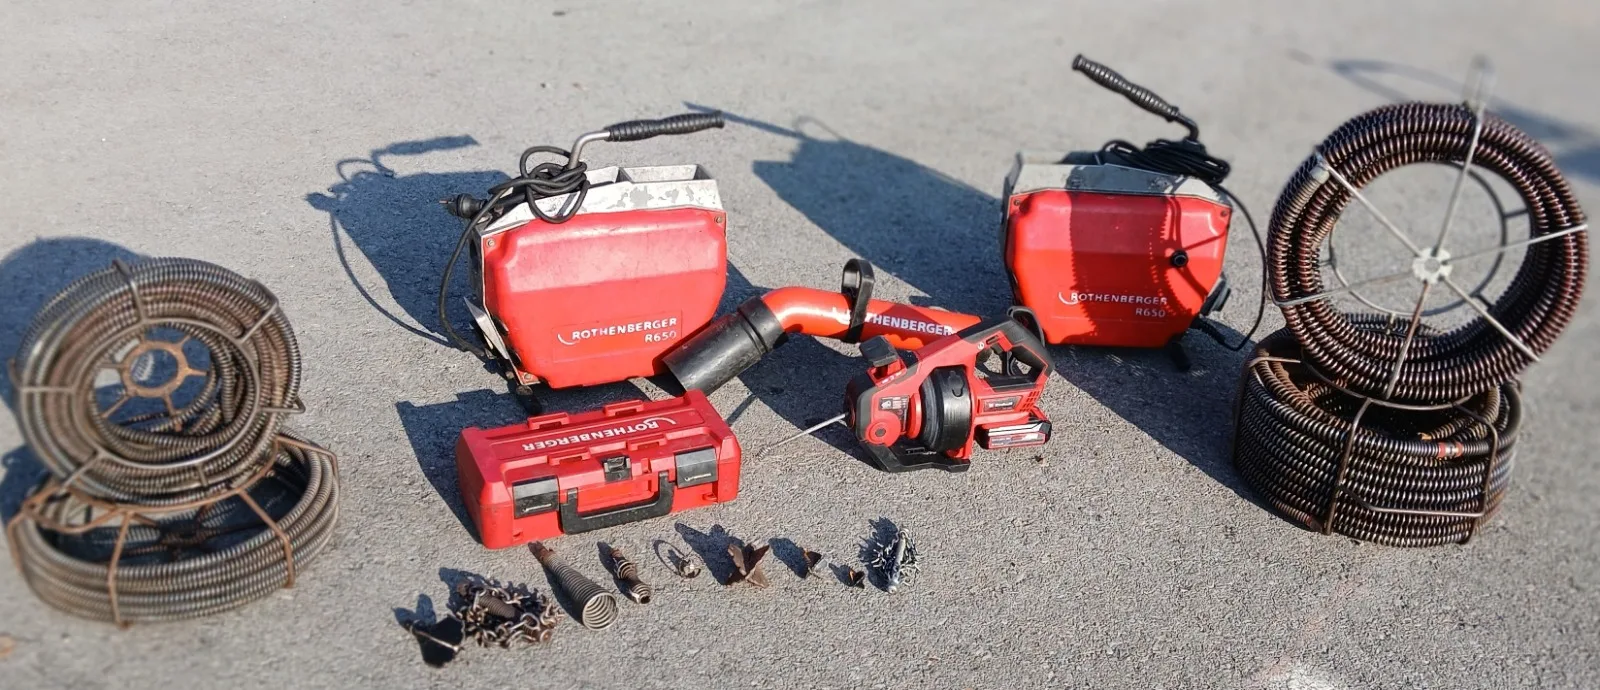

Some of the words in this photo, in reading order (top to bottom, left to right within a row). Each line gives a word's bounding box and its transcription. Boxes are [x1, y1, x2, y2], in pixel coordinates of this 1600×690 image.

[1070, 292, 1168, 306] ROTHENBERGER
[1135, 307, 1167, 318] R650
[571, 317, 678, 341] ROTHENBERGER
[644, 330, 677, 343] R650
[522, 419, 660, 451] ROTHENBERGER
